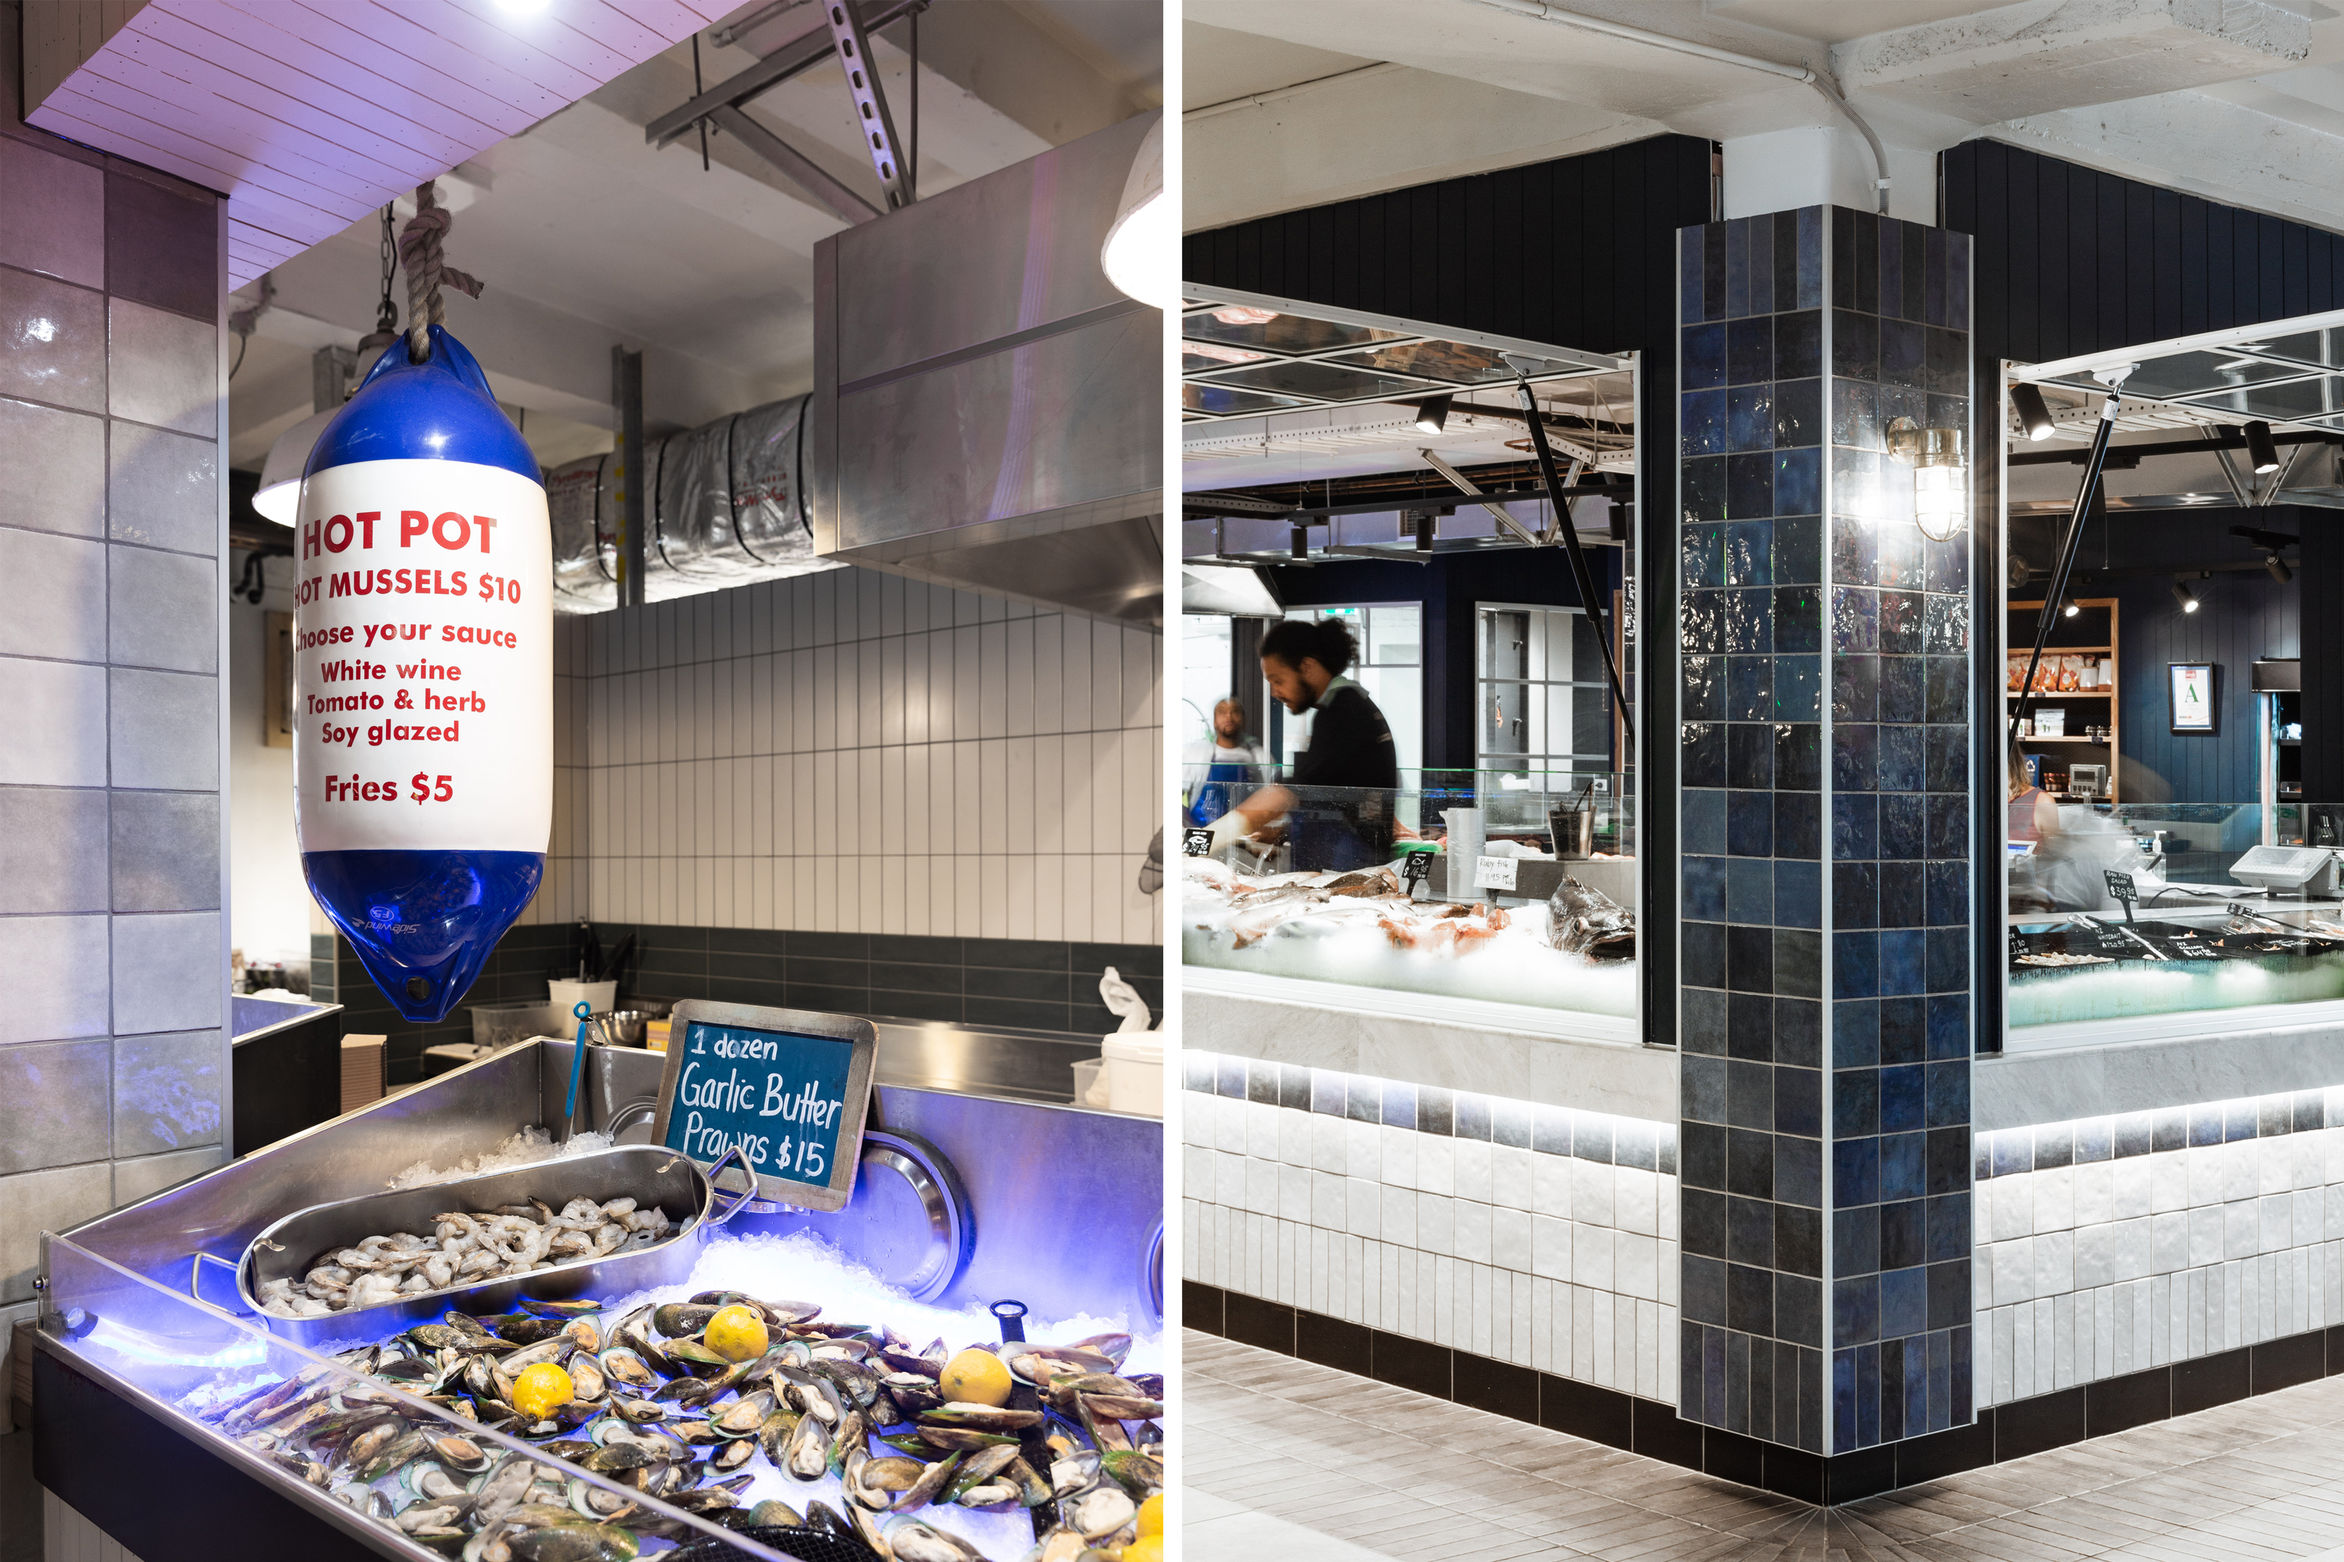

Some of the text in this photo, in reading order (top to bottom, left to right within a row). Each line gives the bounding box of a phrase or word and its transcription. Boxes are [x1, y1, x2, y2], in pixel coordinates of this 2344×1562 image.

[303, 510, 497, 560] HOT POT
[329, 569, 467, 598] MUSSELS
[478, 573, 521, 604] $10
[363, 623, 432, 647] your
[442, 624, 517, 649] sauce
[321, 658, 462, 683] White wine
[308, 688, 486, 714] Tomato & herb
[322, 719, 459, 747] Soy glazed
[325, 771, 453, 805] Fries $5
[364, 921, 421, 935] Sidewind
[691, 1028, 778, 1061] 1 dozen
[681, 1062, 843, 1129] Garlic Butter
[683, 1111, 825, 1177] Prawns $15
